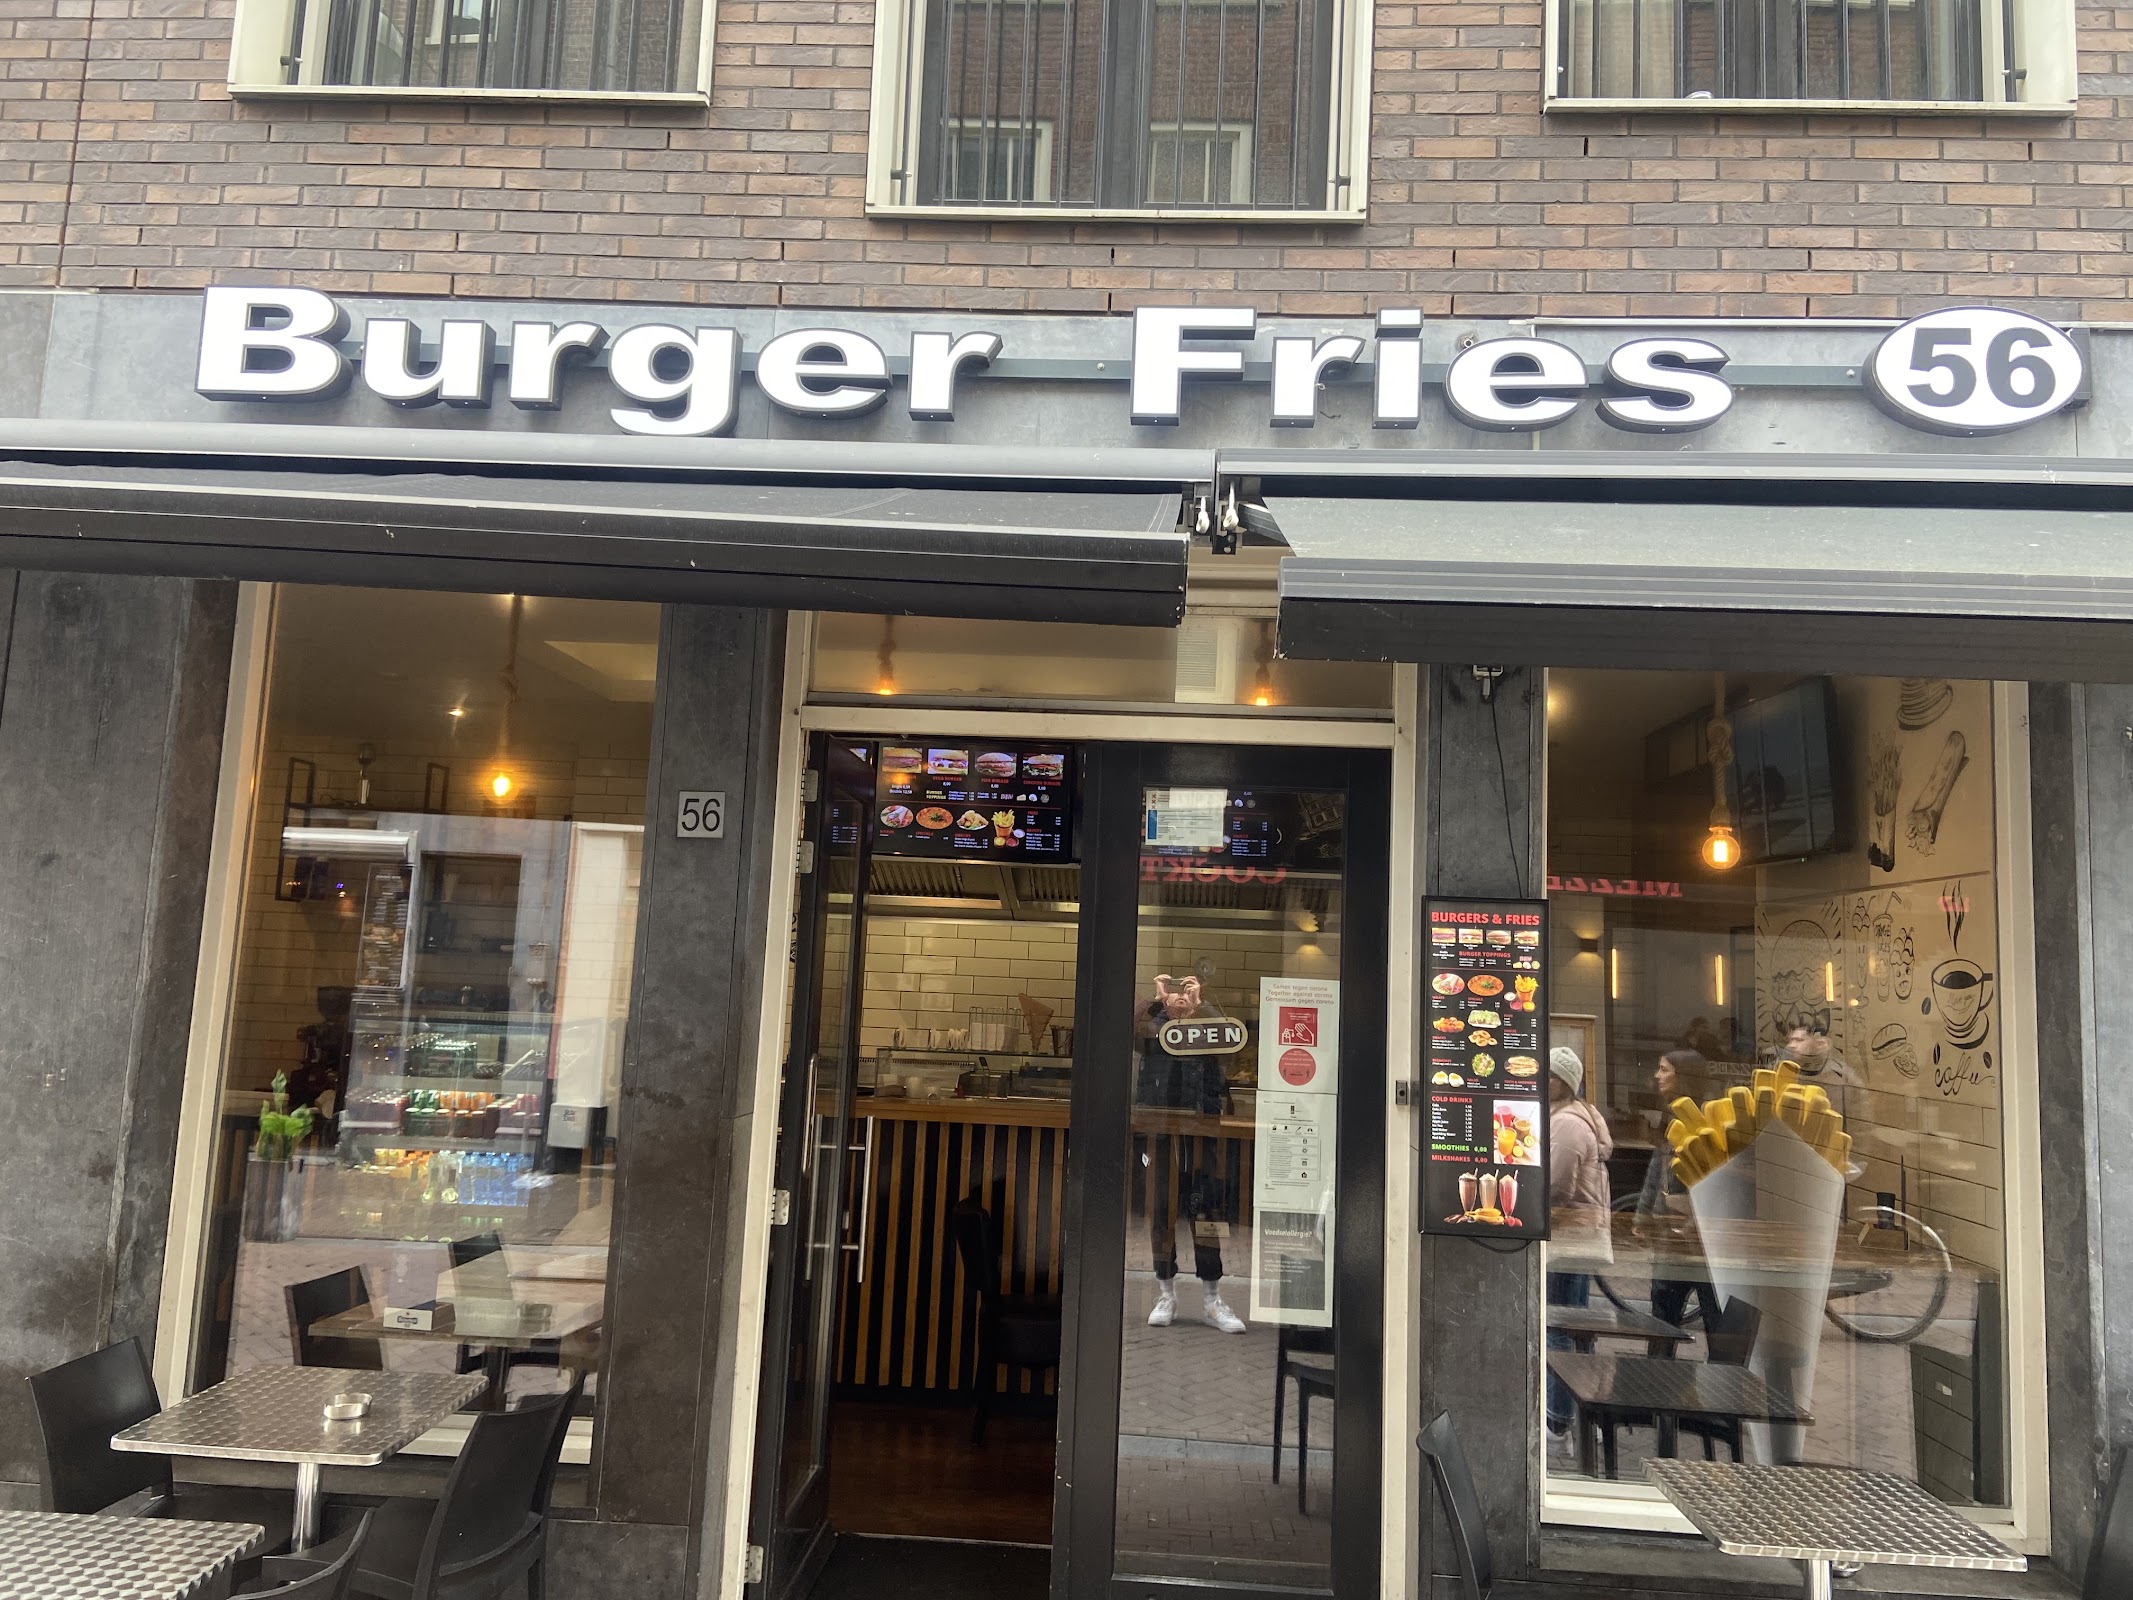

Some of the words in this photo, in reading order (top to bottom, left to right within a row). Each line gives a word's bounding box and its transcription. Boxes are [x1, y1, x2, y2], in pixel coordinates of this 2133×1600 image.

[195, 285, 1003, 436] Burger
[1131, 306, 1735, 434] Fries
[1907, 326, 2056, 409] 56
[682, 799, 720, 831] 56
[1431, 911, 1489, 924] BURGERS
[1492, 914, 1502, 924] &
[1505, 914, 1540, 926] FRIES
[1166, 1028, 1240, 1044] OPEN
[1431, 1143, 1470, 1152] SMOOTHIES
[1431, 1154, 1471, 1163] MILKSHAKES
[1264, 1228, 1312, 1239] Voedselallergie?
